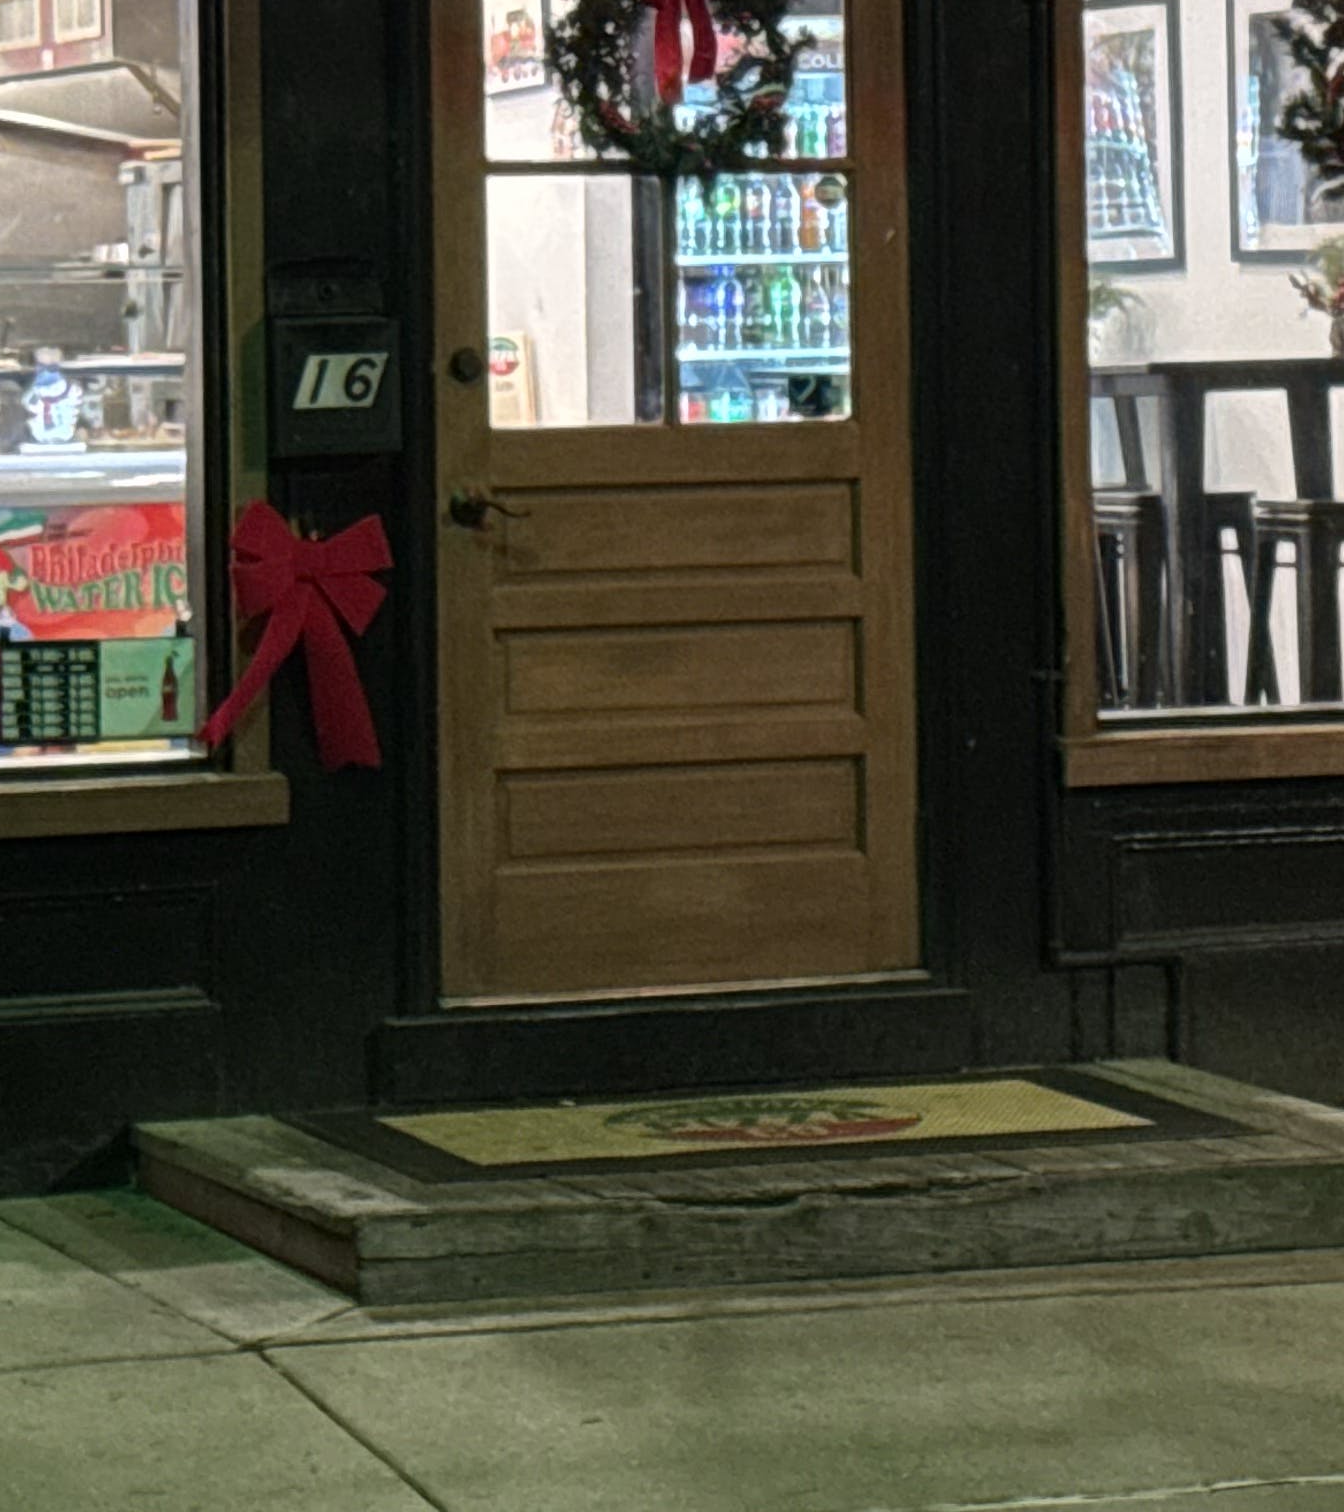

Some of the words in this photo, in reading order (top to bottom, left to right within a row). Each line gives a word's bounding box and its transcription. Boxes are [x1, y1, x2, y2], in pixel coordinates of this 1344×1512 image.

[309, 357, 378, 403] 16
[29, 538, 185, 585] Philadelphi
[30, 567, 144, 613] WATER
[152, 561, 186, 609] IC
